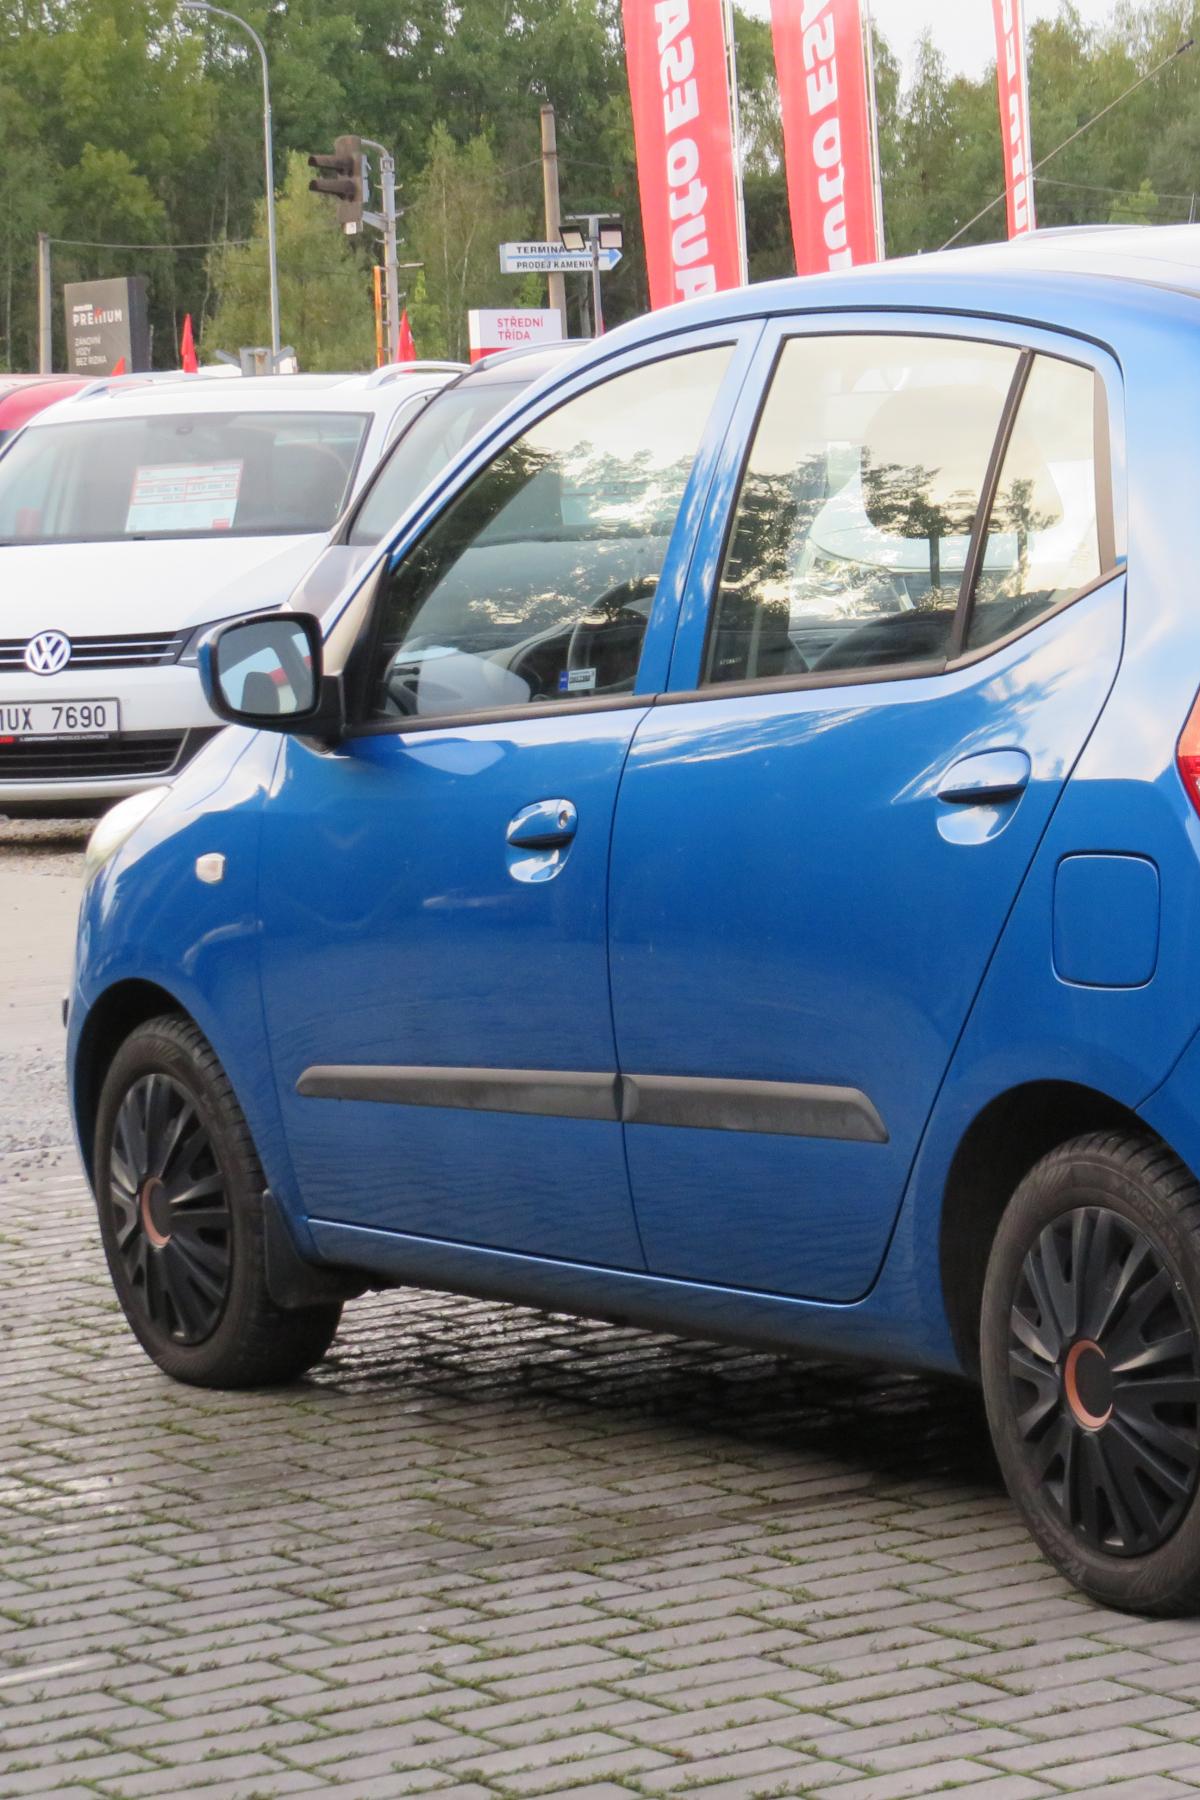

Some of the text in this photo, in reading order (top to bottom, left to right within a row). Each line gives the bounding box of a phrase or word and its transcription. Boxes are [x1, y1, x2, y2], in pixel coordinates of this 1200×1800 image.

[517, 258, 594, 269] PRODEJ KAMENIV
[497, 316, 543, 328] STŘEDNÍ
[499, 329, 531, 340] TŘÍDA
[52, 705, 106, 729] 7690
